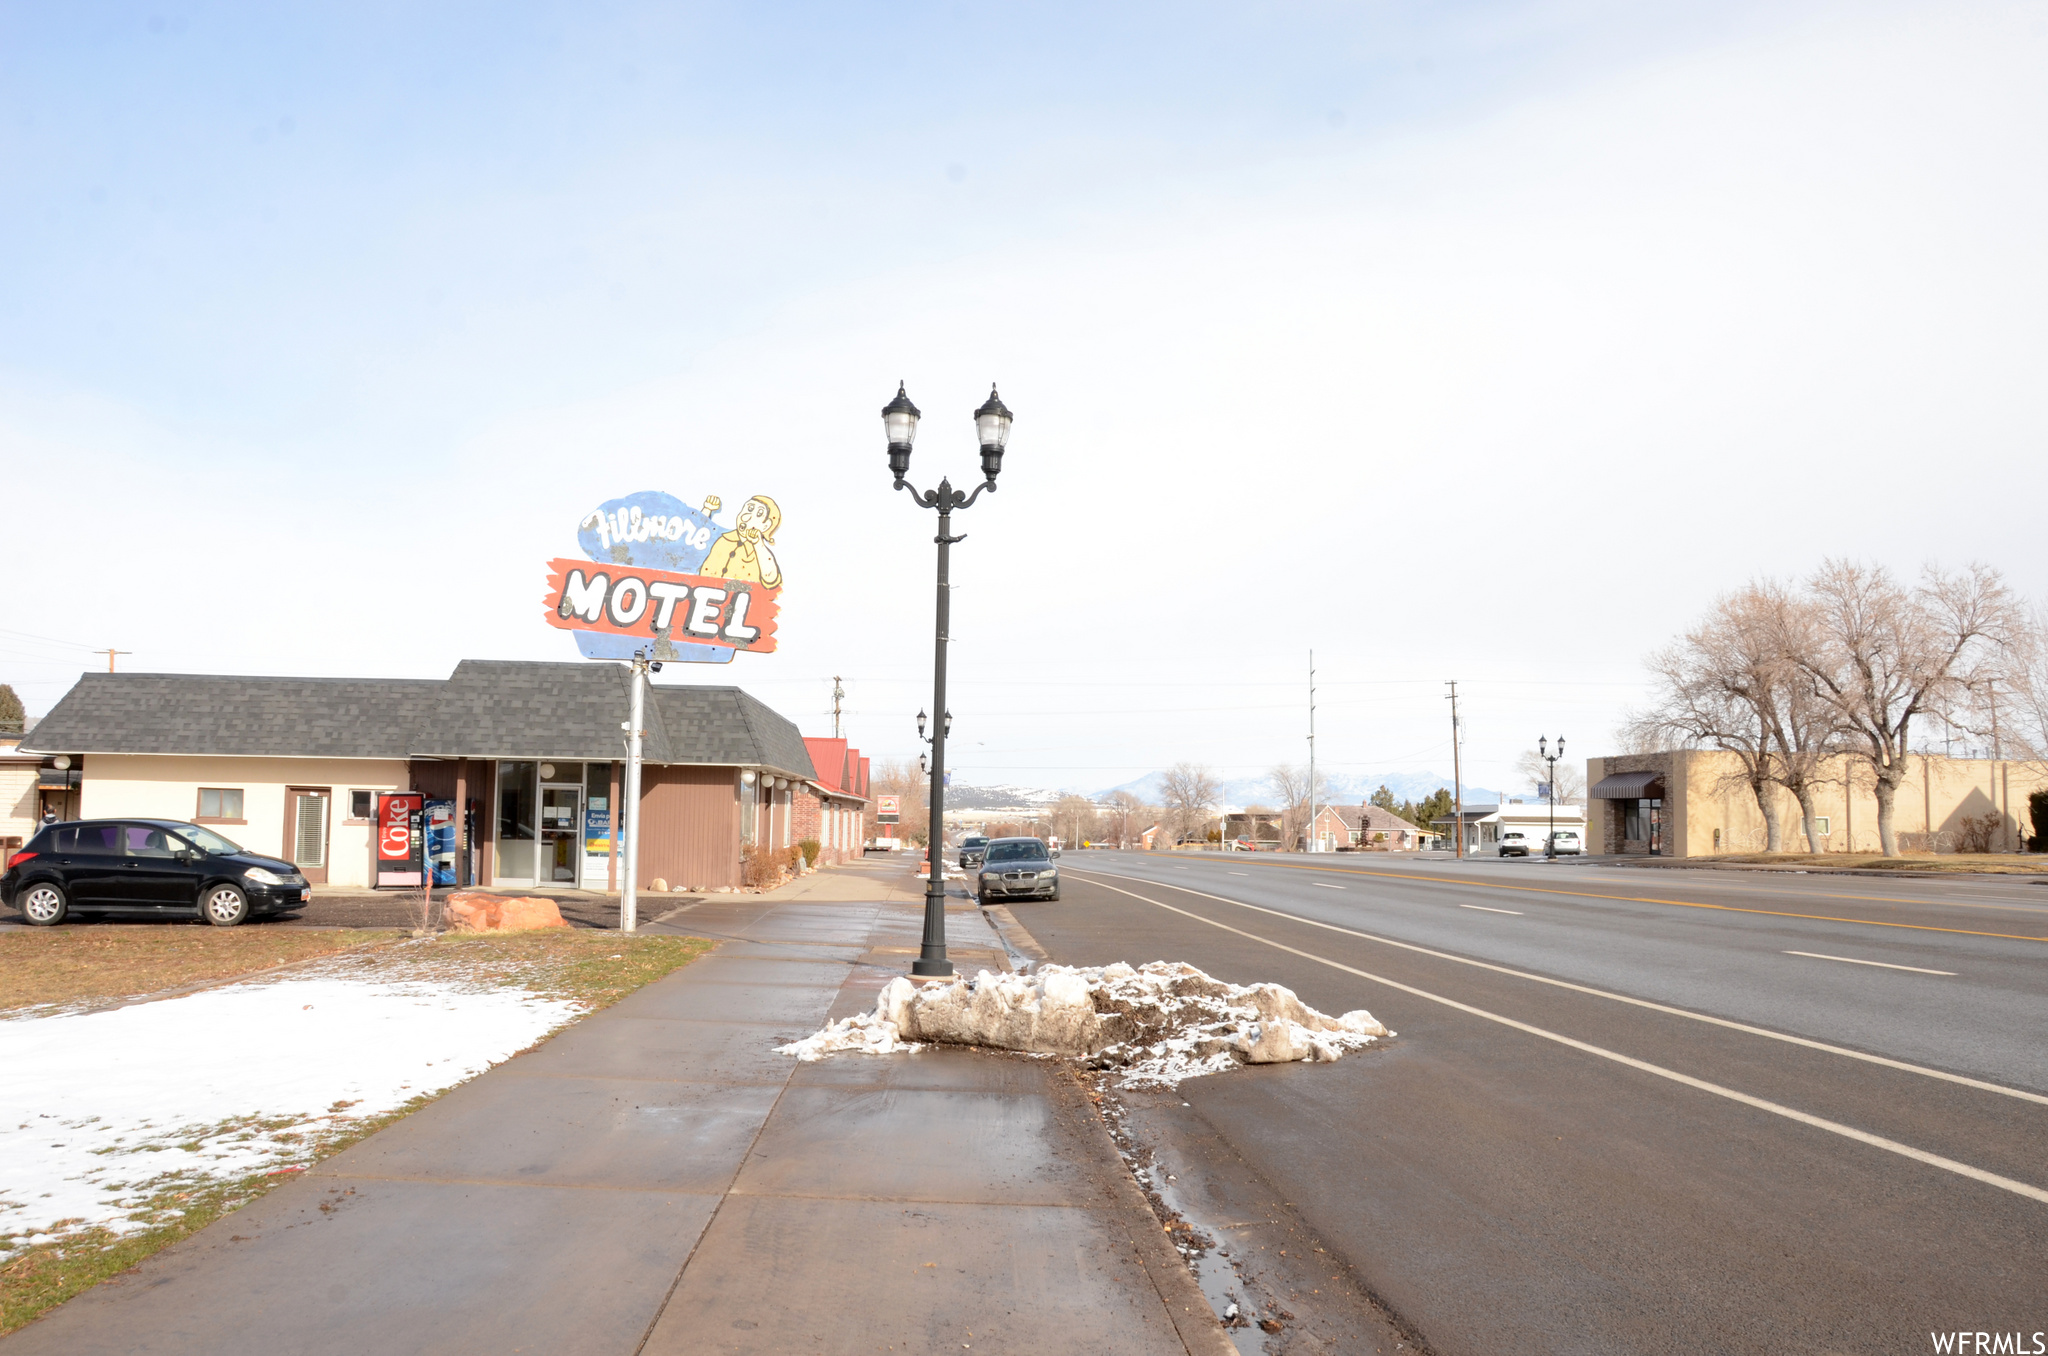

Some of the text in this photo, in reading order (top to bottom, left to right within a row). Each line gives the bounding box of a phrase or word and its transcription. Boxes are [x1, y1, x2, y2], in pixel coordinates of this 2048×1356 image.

[582, 506, 711, 550] Fillmore
[558, 569, 759, 641] MOTEL
[381, 800, 409, 857] Coke
